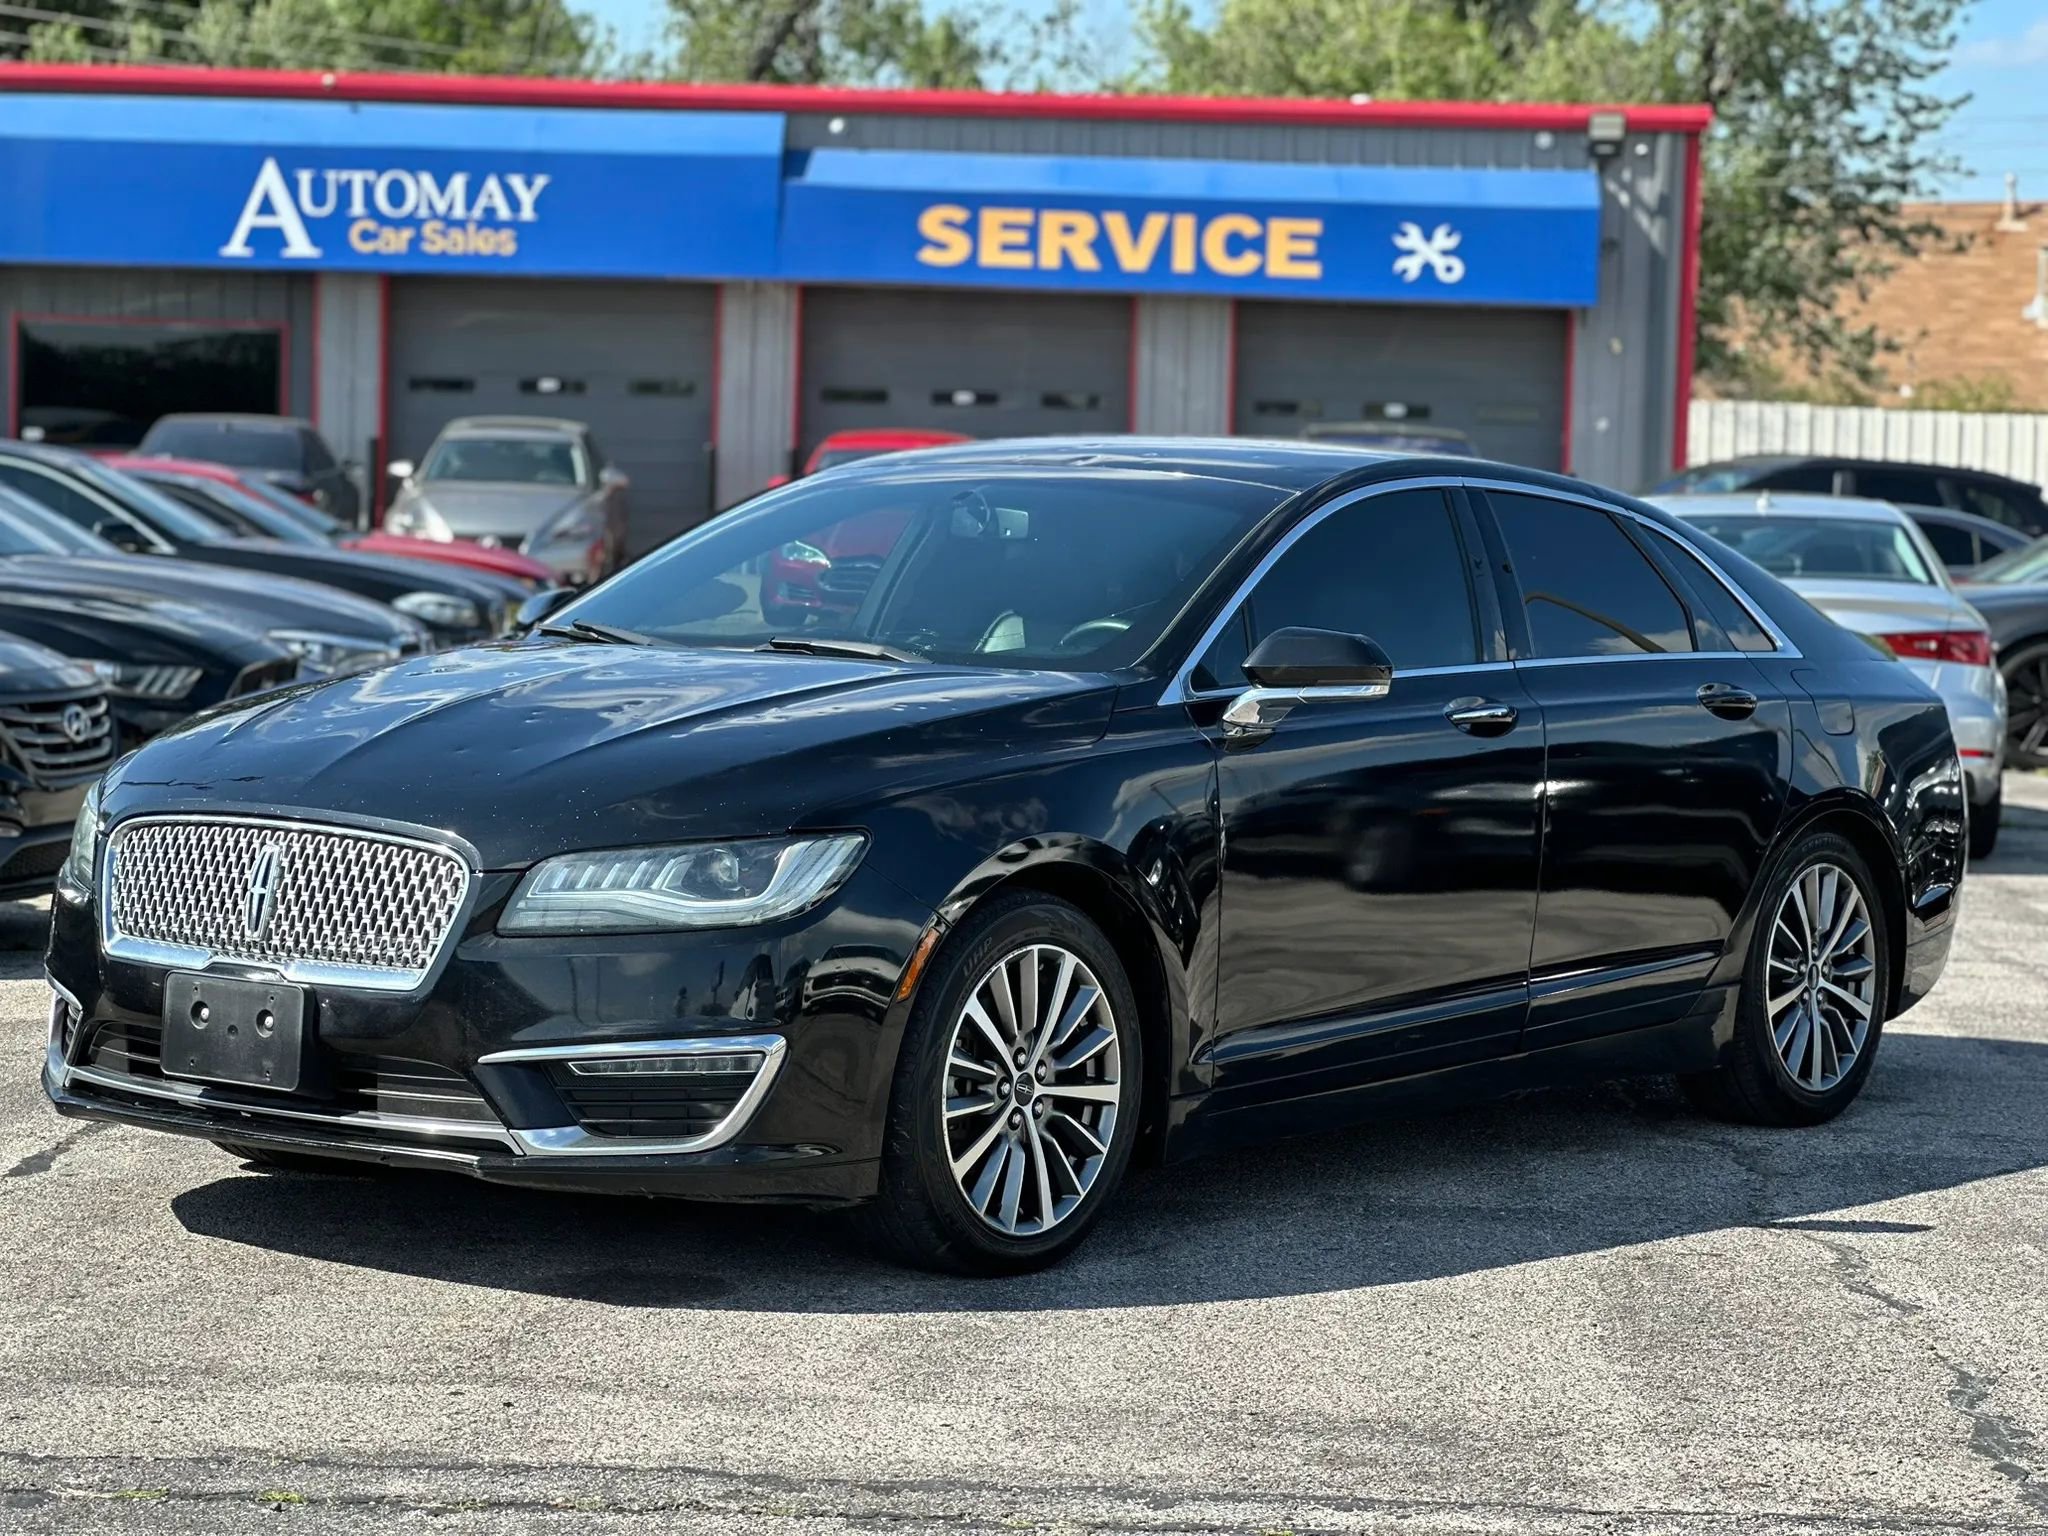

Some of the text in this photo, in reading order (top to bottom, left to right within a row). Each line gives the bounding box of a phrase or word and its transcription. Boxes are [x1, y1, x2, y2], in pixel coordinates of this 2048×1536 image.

[219, 156, 552, 258] AUTOMAY
[349, 219, 518, 256] Car Sales
[916, 204, 1323, 279] SERVICE
